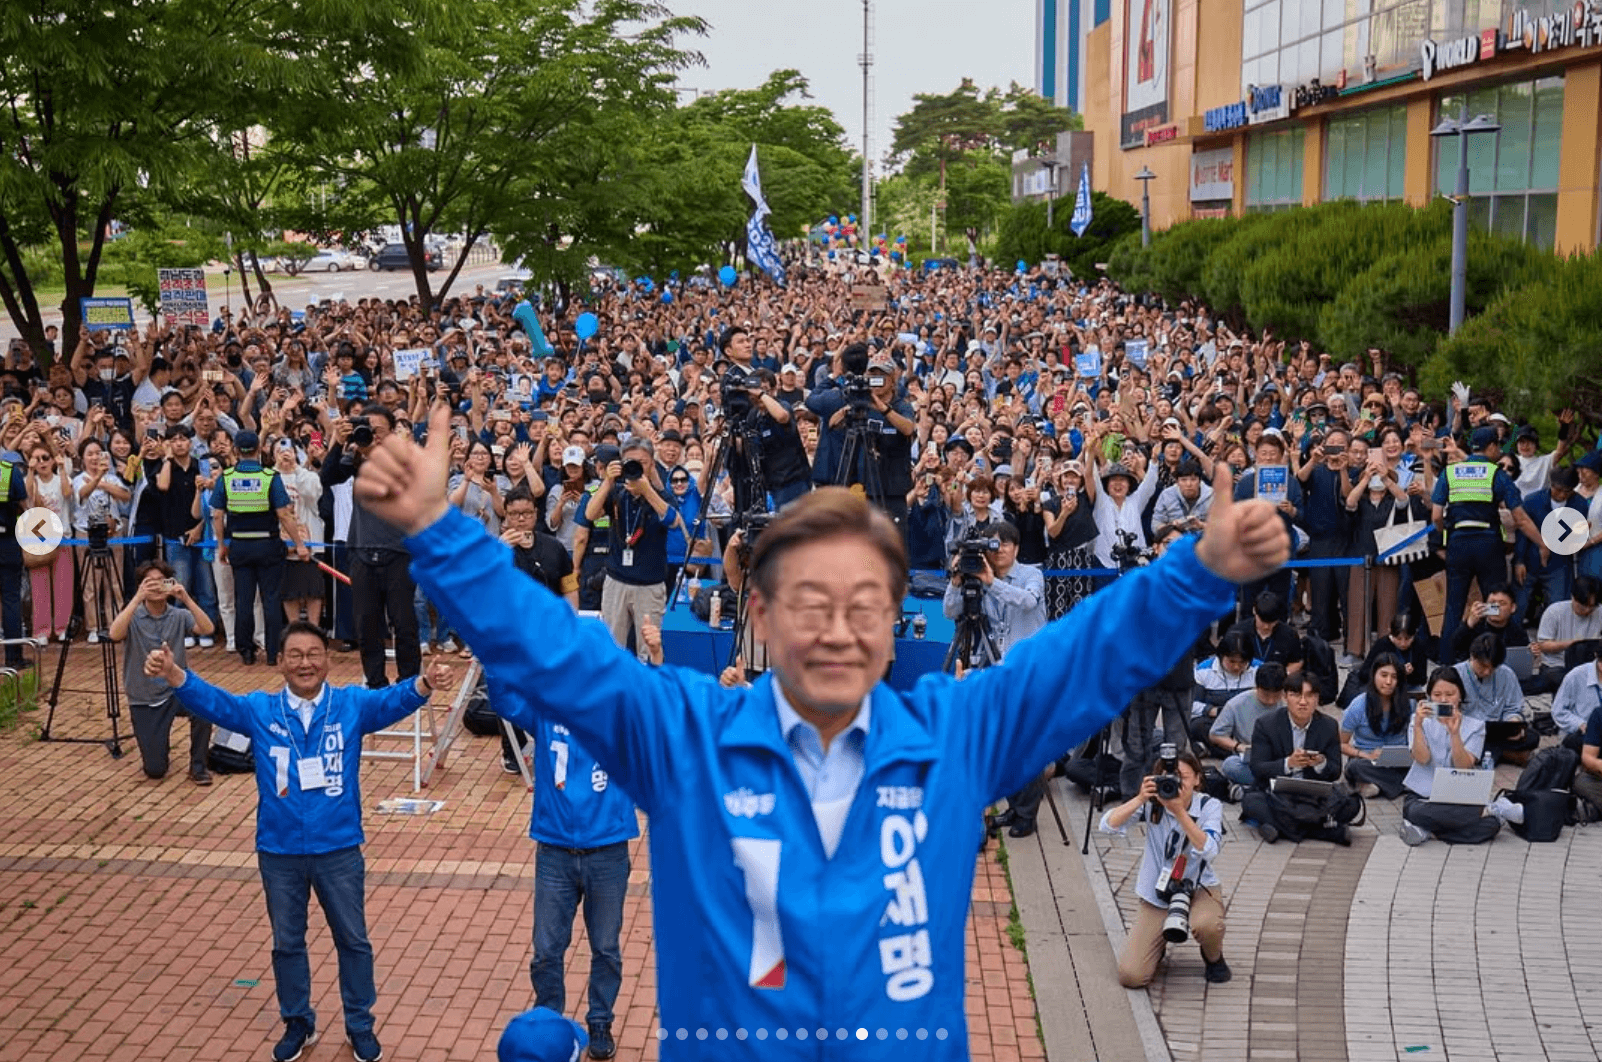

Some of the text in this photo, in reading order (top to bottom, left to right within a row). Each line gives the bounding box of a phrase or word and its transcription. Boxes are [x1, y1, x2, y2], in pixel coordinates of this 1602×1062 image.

[269, 745, 291, 798] 1
[323, 731, 344, 797] 이재명
[878, 809, 935, 1002] 이재명
